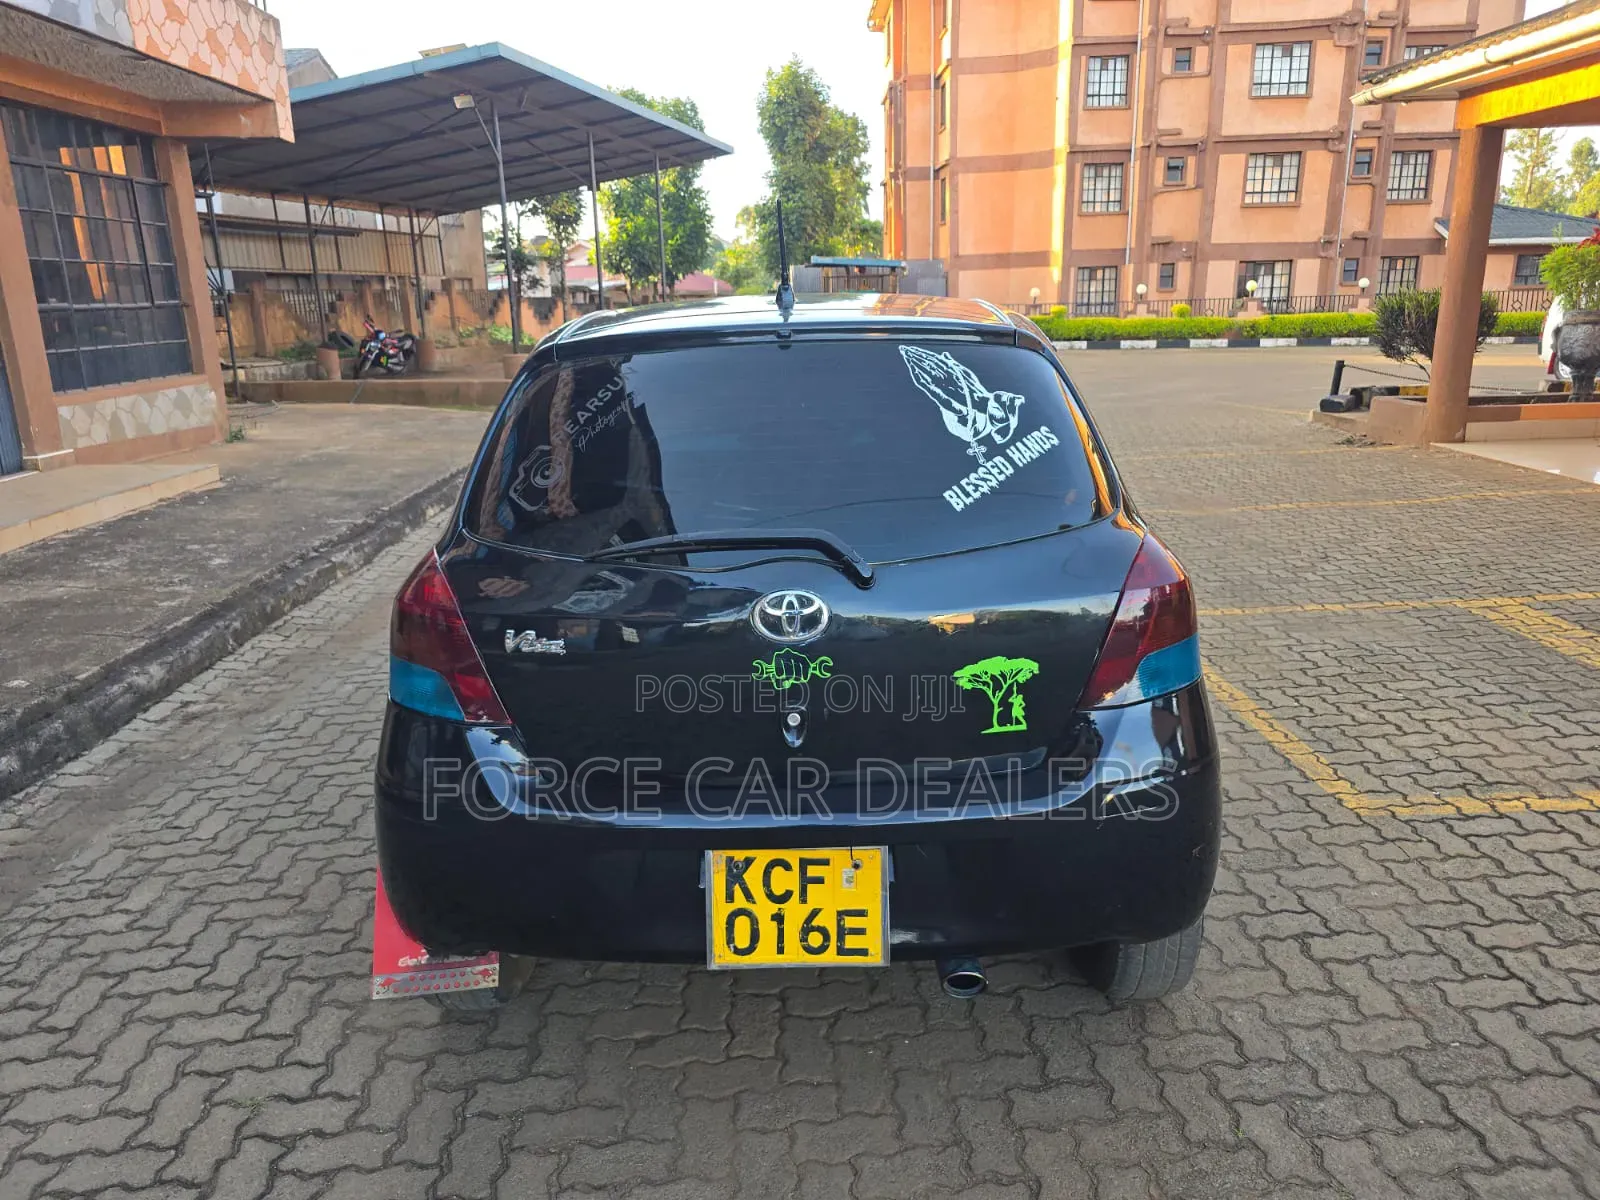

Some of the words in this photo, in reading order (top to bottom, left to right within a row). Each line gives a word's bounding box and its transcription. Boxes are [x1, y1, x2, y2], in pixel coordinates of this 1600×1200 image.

[943, 455, 1014, 512] BLESSED
[1006, 425, 1060, 467] HANDS
[725, 856, 830, 904] KCF
[725, 907, 869, 957] 016E
